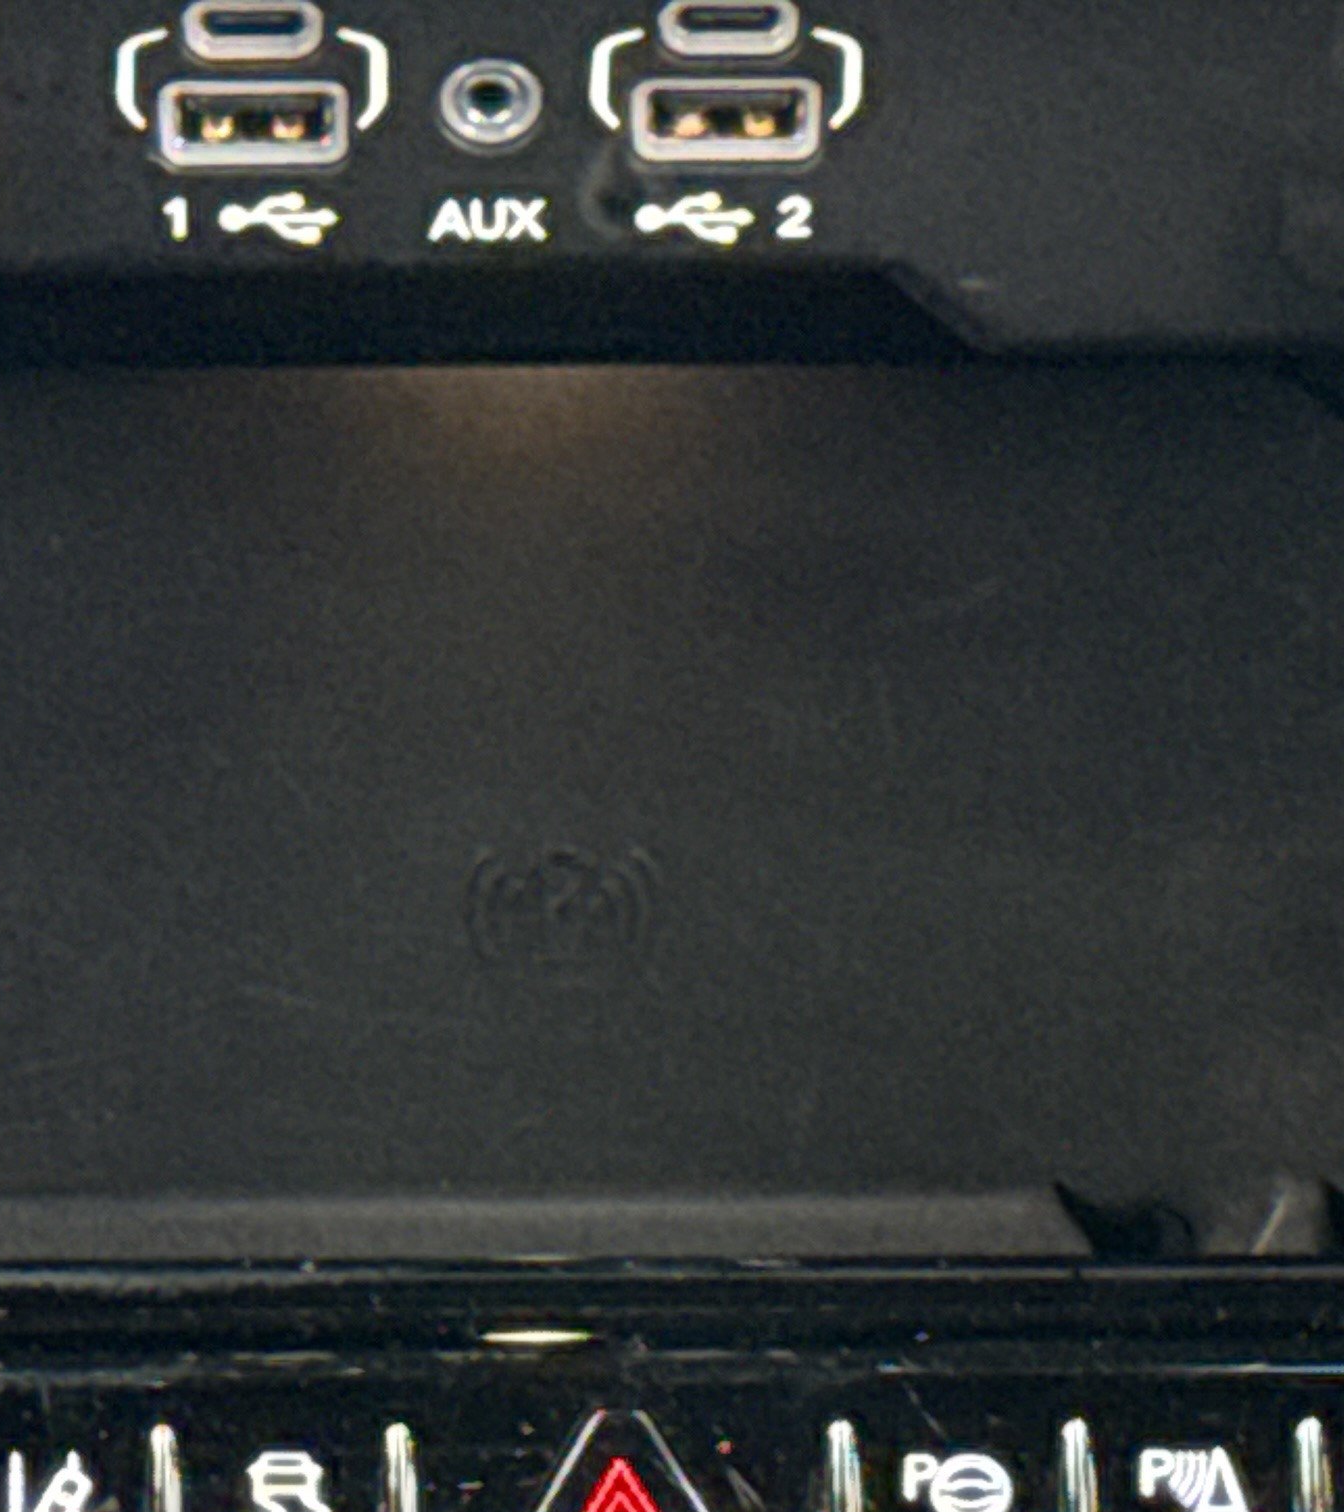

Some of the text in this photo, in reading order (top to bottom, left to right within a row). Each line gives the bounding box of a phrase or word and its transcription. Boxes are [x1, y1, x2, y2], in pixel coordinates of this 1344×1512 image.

[162, 197, 188, 240] 1
[427, 199, 547, 242] AUX
[776, 194, 812, 239] 2
